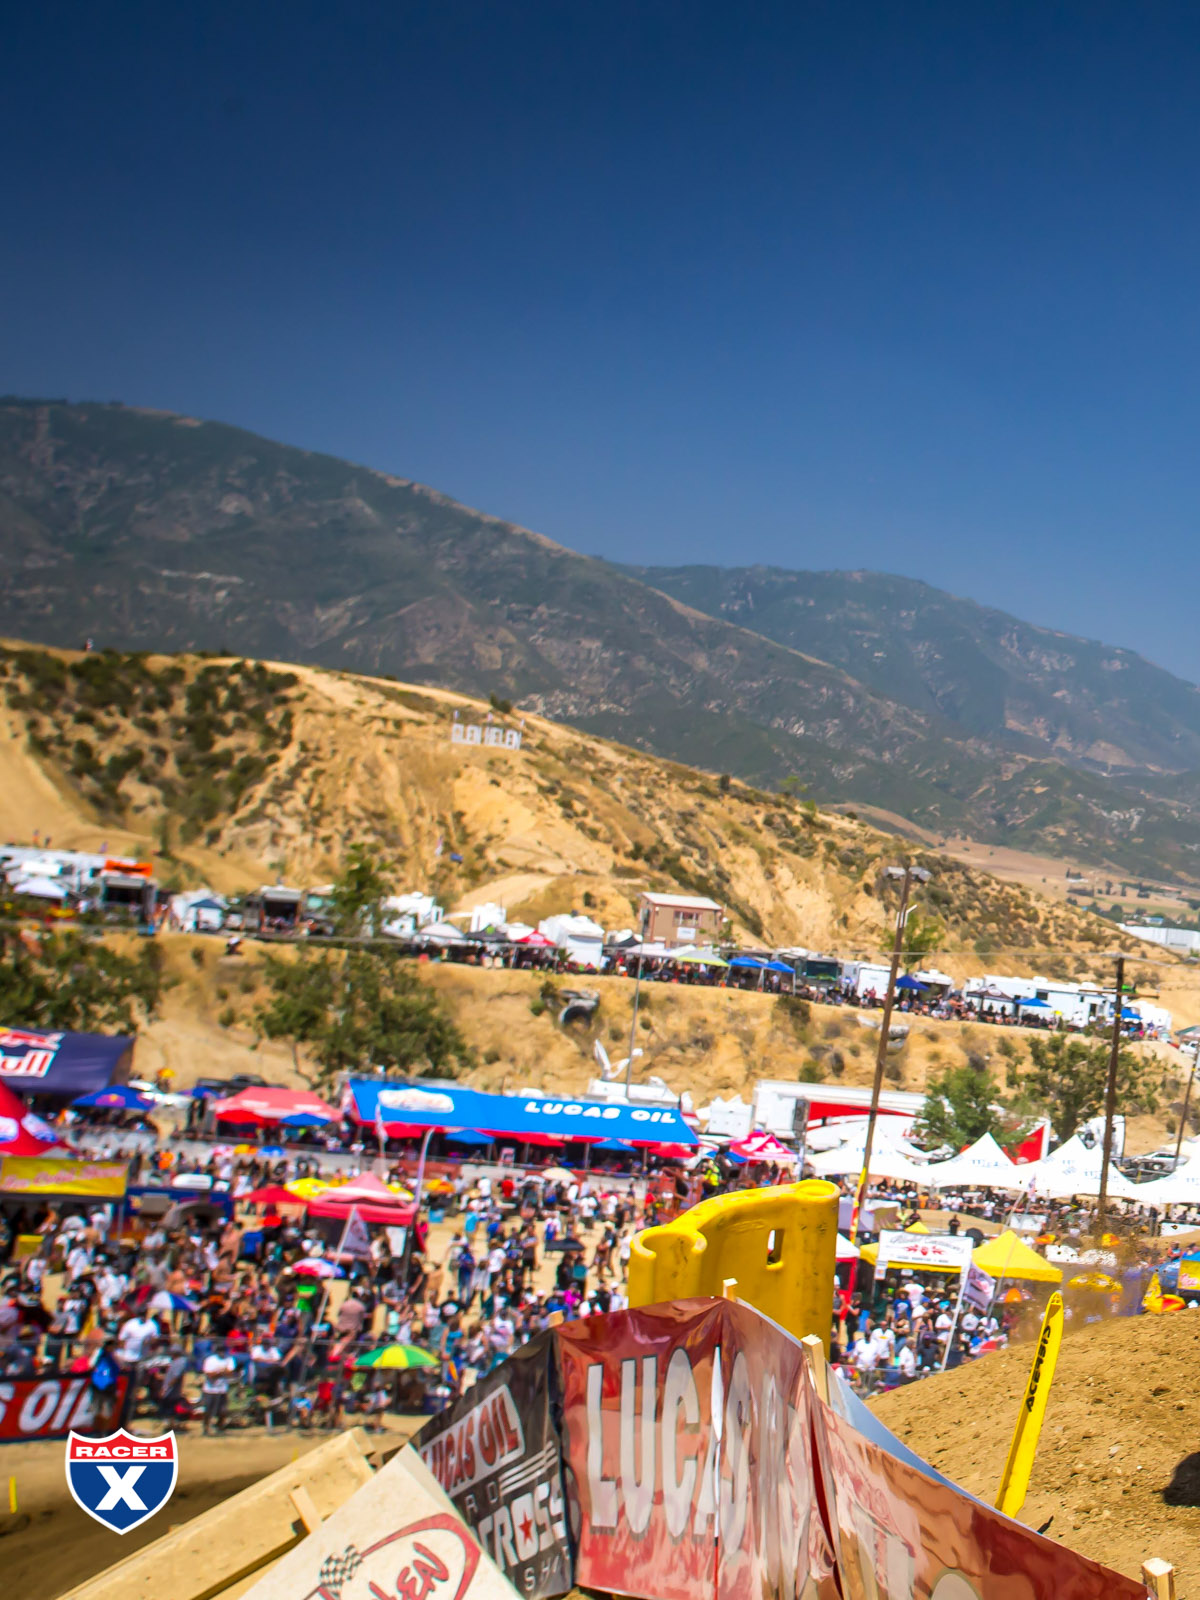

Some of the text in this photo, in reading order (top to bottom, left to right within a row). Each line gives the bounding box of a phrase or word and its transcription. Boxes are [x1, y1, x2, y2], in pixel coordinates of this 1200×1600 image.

[0, 1049, 56, 1078] ull
[524, 1100, 677, 1125] LUCAS OIL
[1026, 1325, 1051, 1413] ACERBIS
[479, 1392, 521, 1467] OIL
